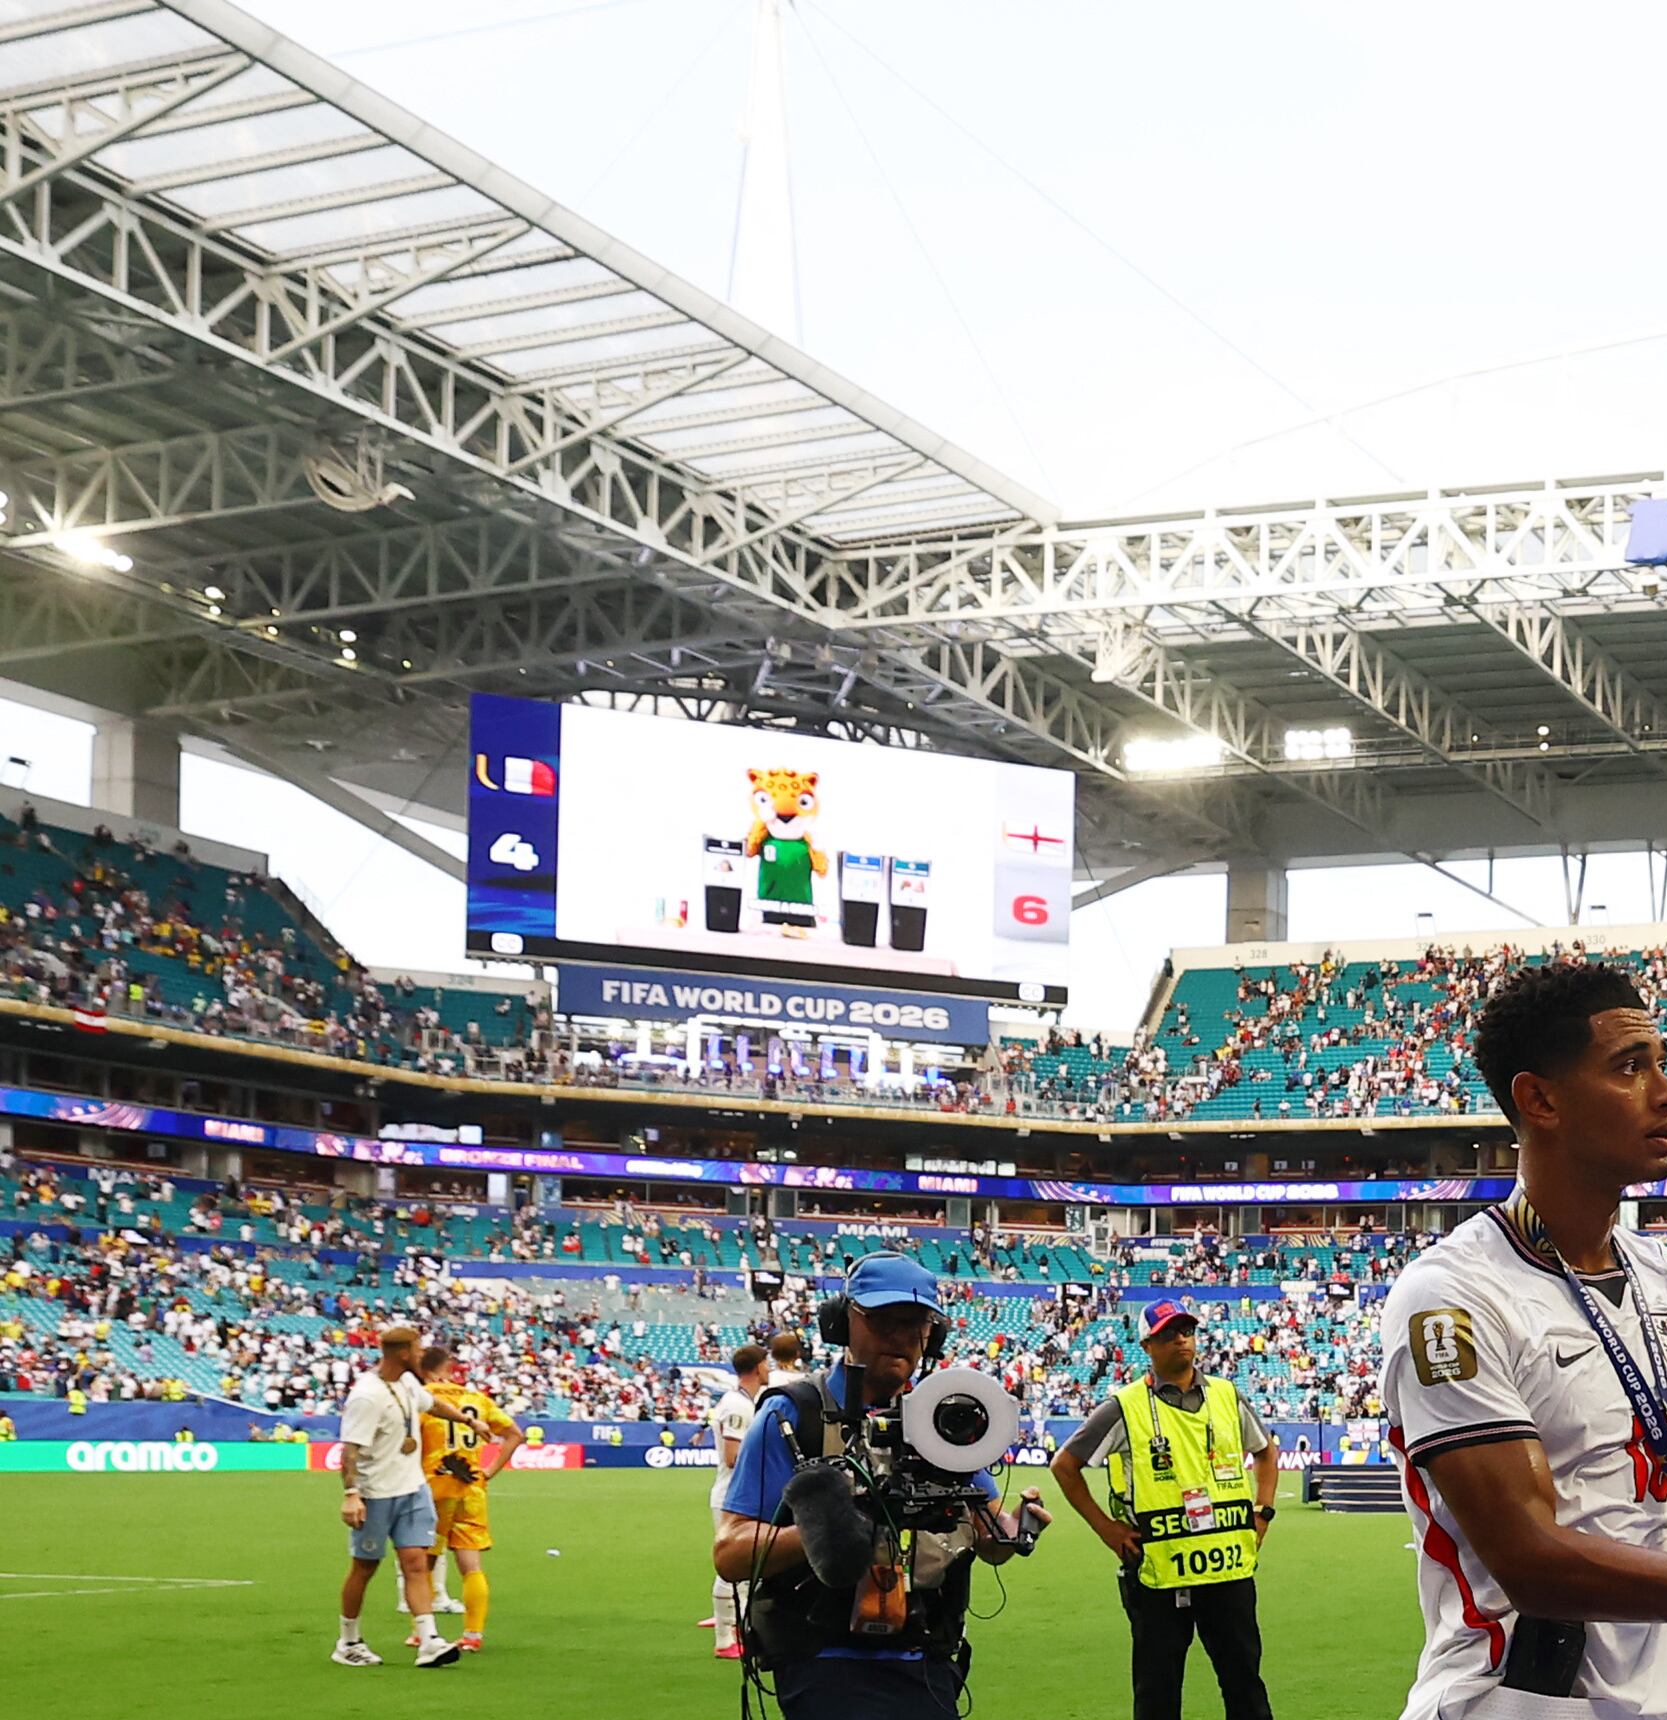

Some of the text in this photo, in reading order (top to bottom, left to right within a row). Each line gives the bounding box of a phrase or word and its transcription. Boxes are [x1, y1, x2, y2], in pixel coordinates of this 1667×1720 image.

[489, 832, 540, 872] 4
[1012, 895, 1049, 926] 6
[601, 979, 950, 1030] FIFA WORLD CUP 2026
[203, 1118, 265, 1144] MIAMI
[438, 1147, 585, 1171] BRONZE FINAL
[918, 1175, 979, 1194] MIAMI
[1170, 1185, 1208, 1202] FIFA
[1208, 1184, 1256, 1202] WORLD
[1256, 1184, 1287, 1201] CUP
[837, 1223, 909, 1239] MIAMI
[1435, 1351, 1450, 1359] FIFA
[1579, 1286, 1663, 1441] FIFA WORLD CUP 2026
[66, 1441, 219, 1472] aramco
[1170, 1544, 1243, 1577] 10932
